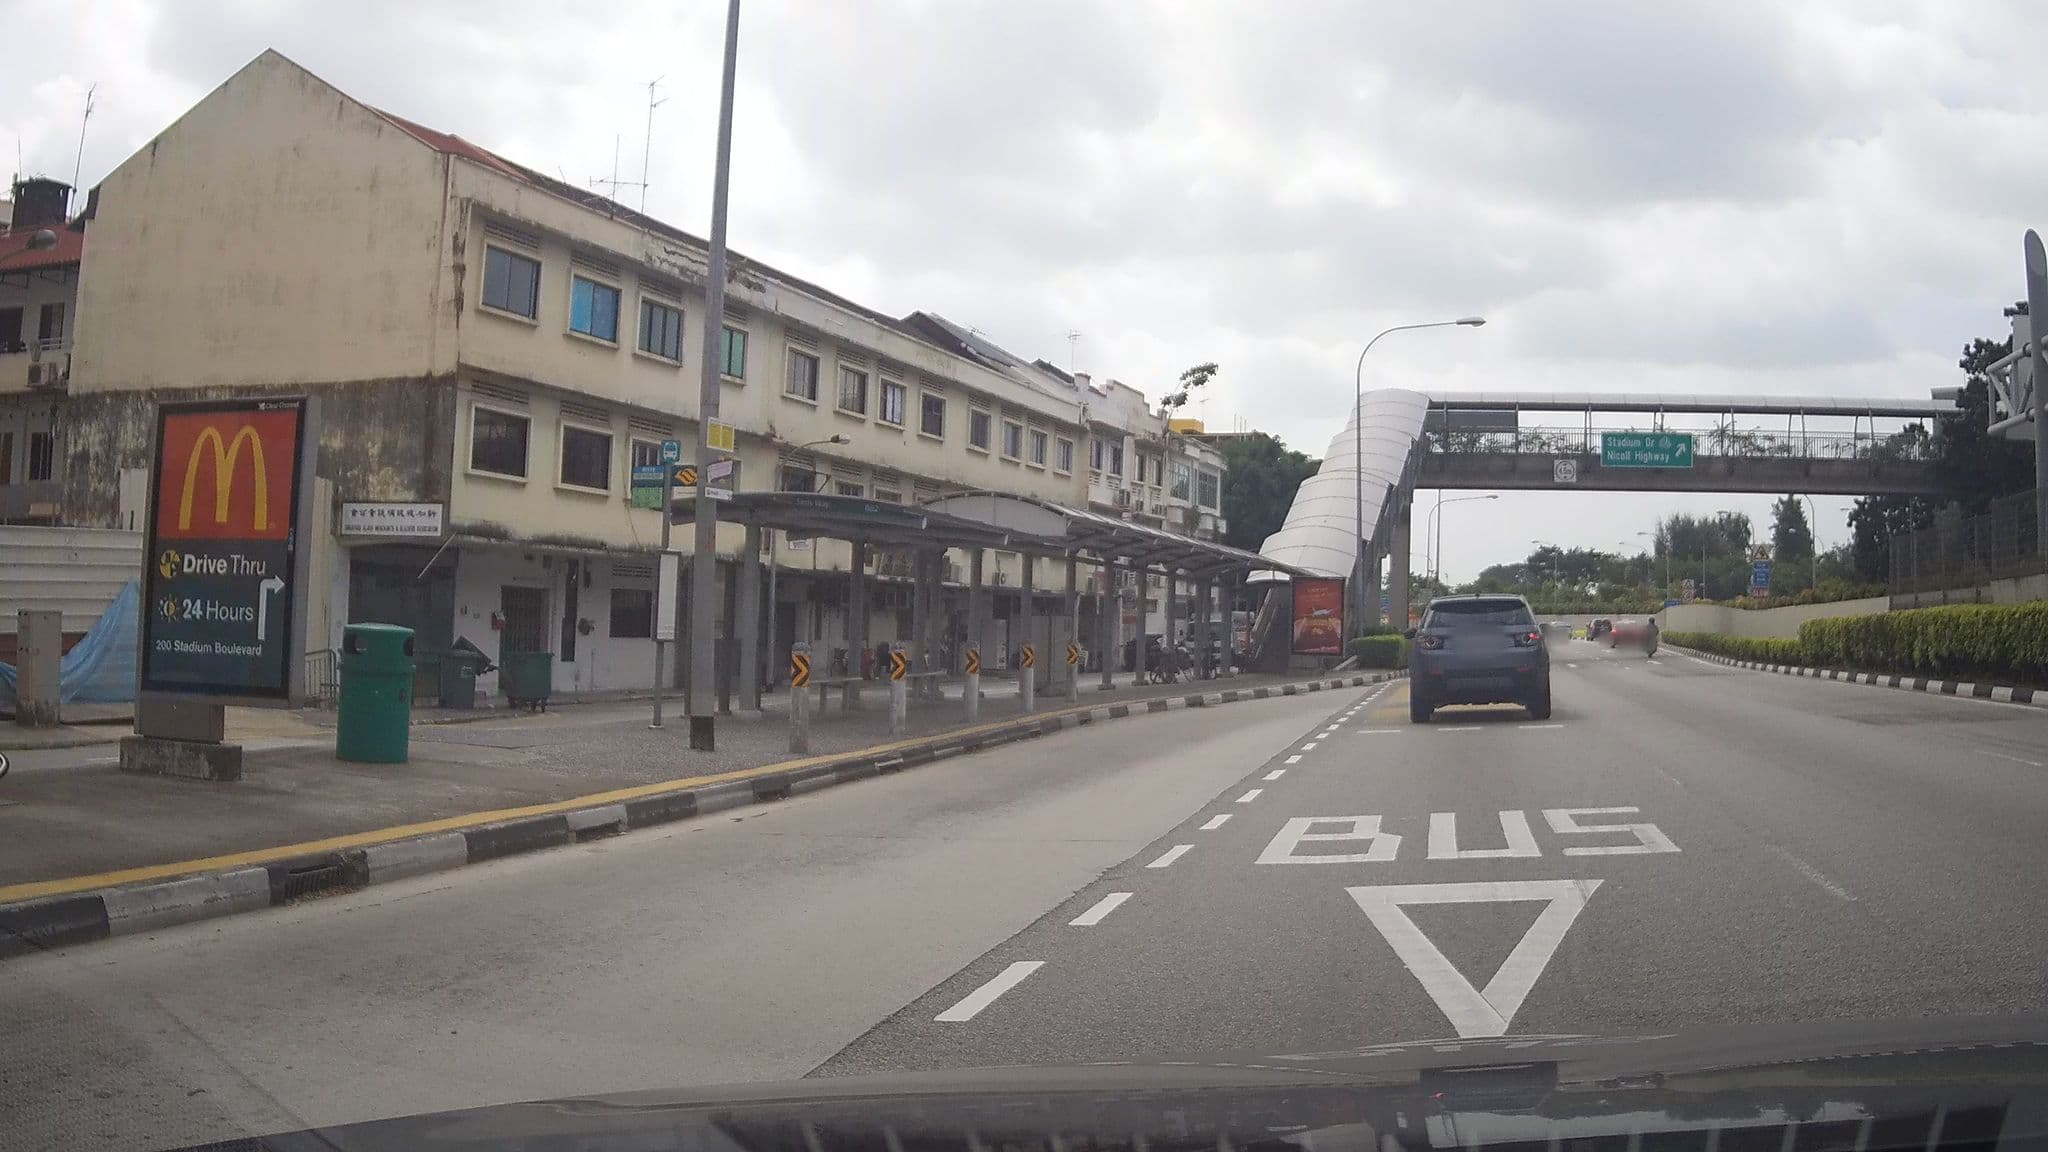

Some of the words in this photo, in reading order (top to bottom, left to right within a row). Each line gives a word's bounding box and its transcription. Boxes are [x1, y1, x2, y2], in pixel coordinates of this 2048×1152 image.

[1607, 437, 1641, 447] Stadium
[1645, 437, 1655, 447] Dr
[1607, 450, 1631, 460] Nicoll
[1635, 451, 1670, 463] Highway
[183, 553, 227, 575] Drive
[230, 554, 266, 575] Thru
[182, 598, 203, 619] 24
[206, 599, 254, 621] Hours
[156, 639, 172, 651] 200
[174, 640, 212, 653] Stadium
[214, 642, 262, 656] Boulevard
[1255, 806, 1682, 864] BUS
